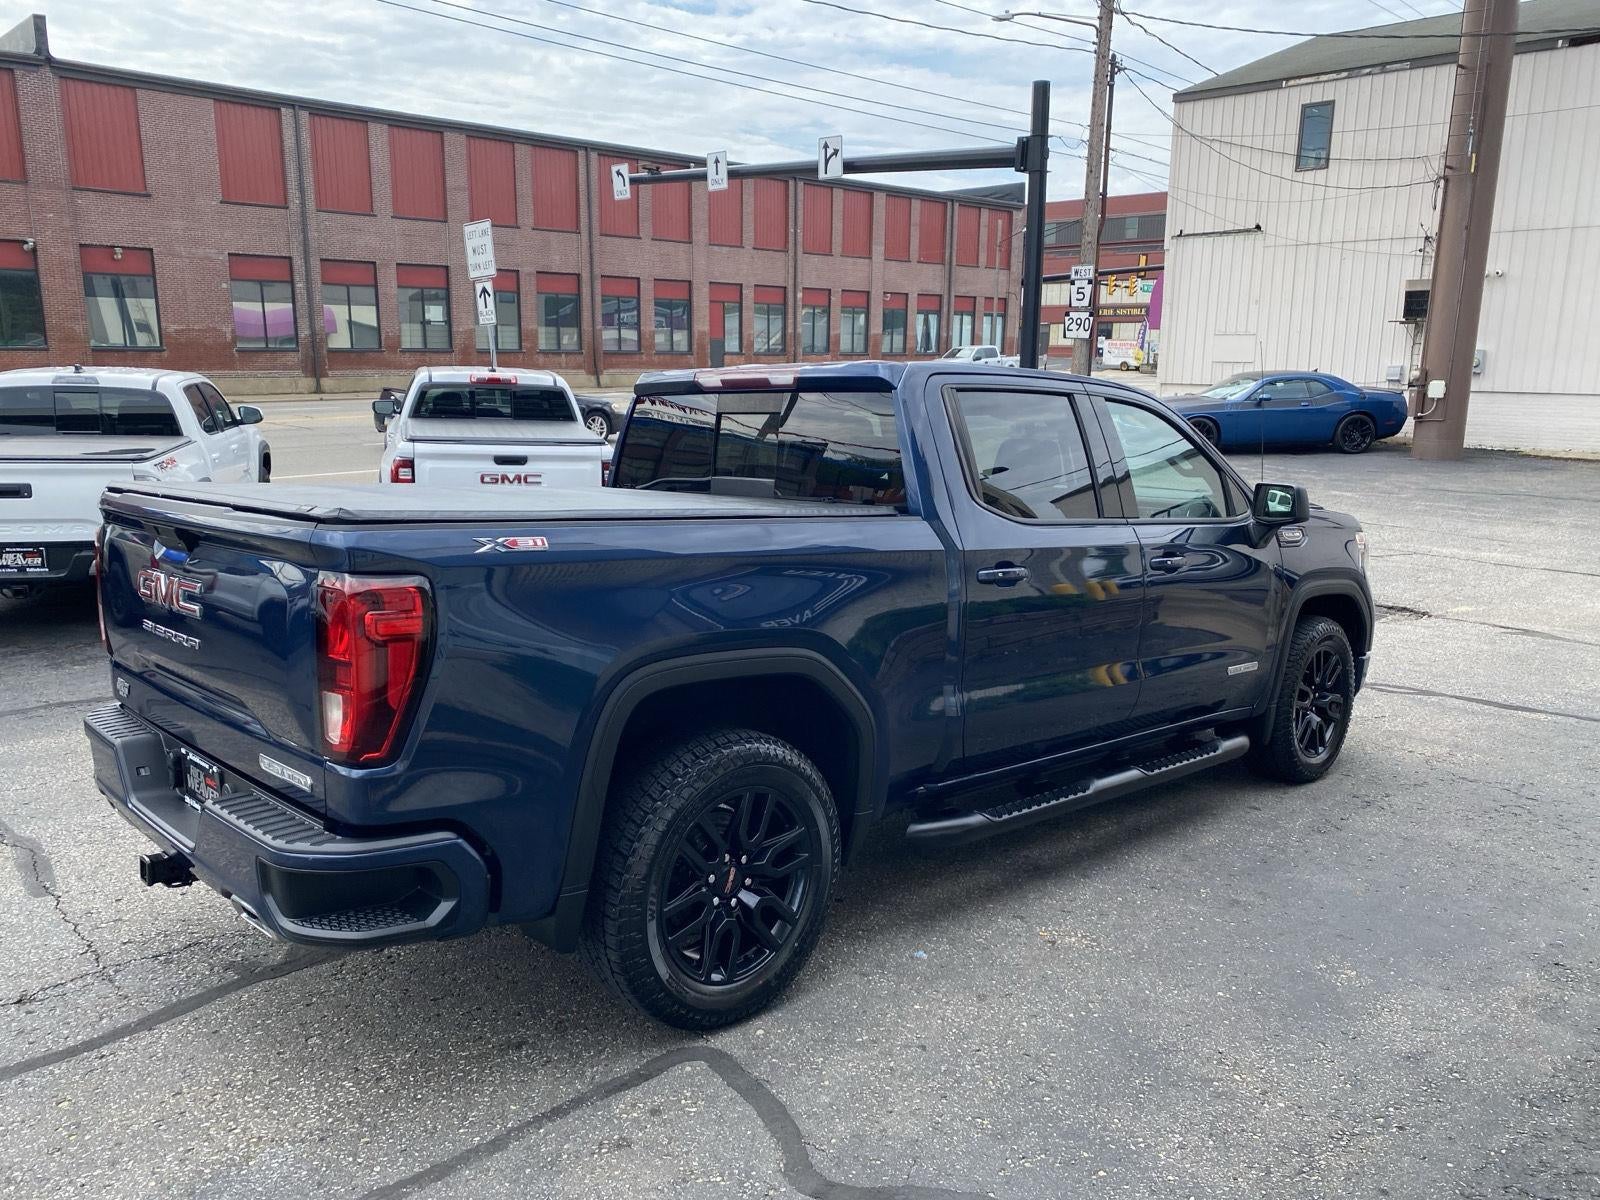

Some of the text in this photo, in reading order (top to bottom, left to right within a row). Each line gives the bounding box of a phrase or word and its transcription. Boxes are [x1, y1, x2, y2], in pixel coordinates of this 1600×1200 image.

[710, 178, 725, 186] ONLY
[466, 227, 490, 241] LEFT LANE
[471, 243, 487, 257] MUST
[469, 259, 493, 273] TURN LEFT
[1073, 268, 1092, 277] WEST
[1075, 286, 1086, 301] 5
[1066, 317, 1091, 332] 290
[480, 473, 542, 485] GMC
[0, 557, 42, 567] WEAVER
[2, 552, 24, 561] RICK
[136, 568, 204, 620] GMC
[142, 618, 202, 650] SIERRA
